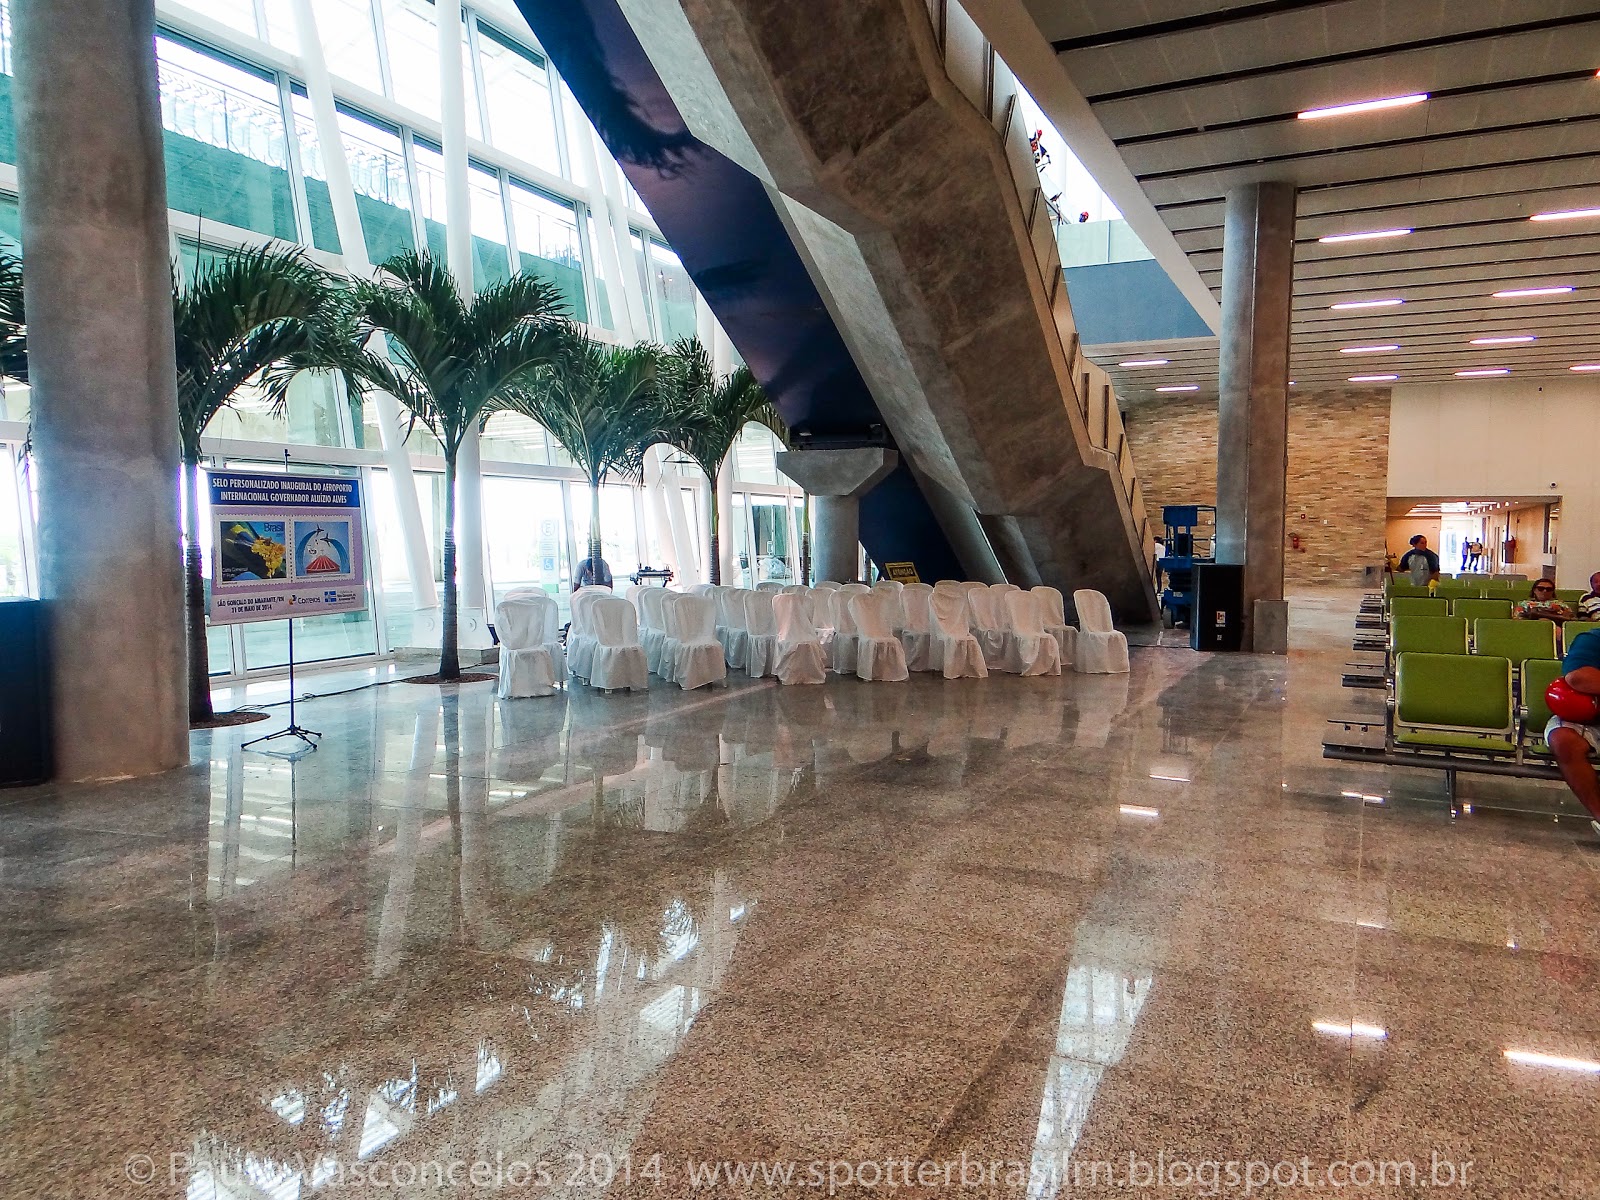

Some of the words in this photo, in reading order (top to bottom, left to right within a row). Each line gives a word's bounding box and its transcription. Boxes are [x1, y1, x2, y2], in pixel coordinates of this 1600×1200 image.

[212, 478, 228, 488] SELO
[229, 479, 280, 490] PERSONALIZADO
[280, 481, 312, 491] INAUGURAL
[313, 482, 321, 492] DO
[322, 483, 352, 493] AEROPORTO
[220, 491, 270, 502] INTERNACIONAL
[270, 492, 310, 503] GOVERNADOR
[310, 493, 331, 504] ALUÍZIO
[332, 495, 347, 504] ALVES
[263, 523, 284, 533] Brasil
[217, 599, 226, 607] SÃO
[297, 597, 321, 605] Correios
